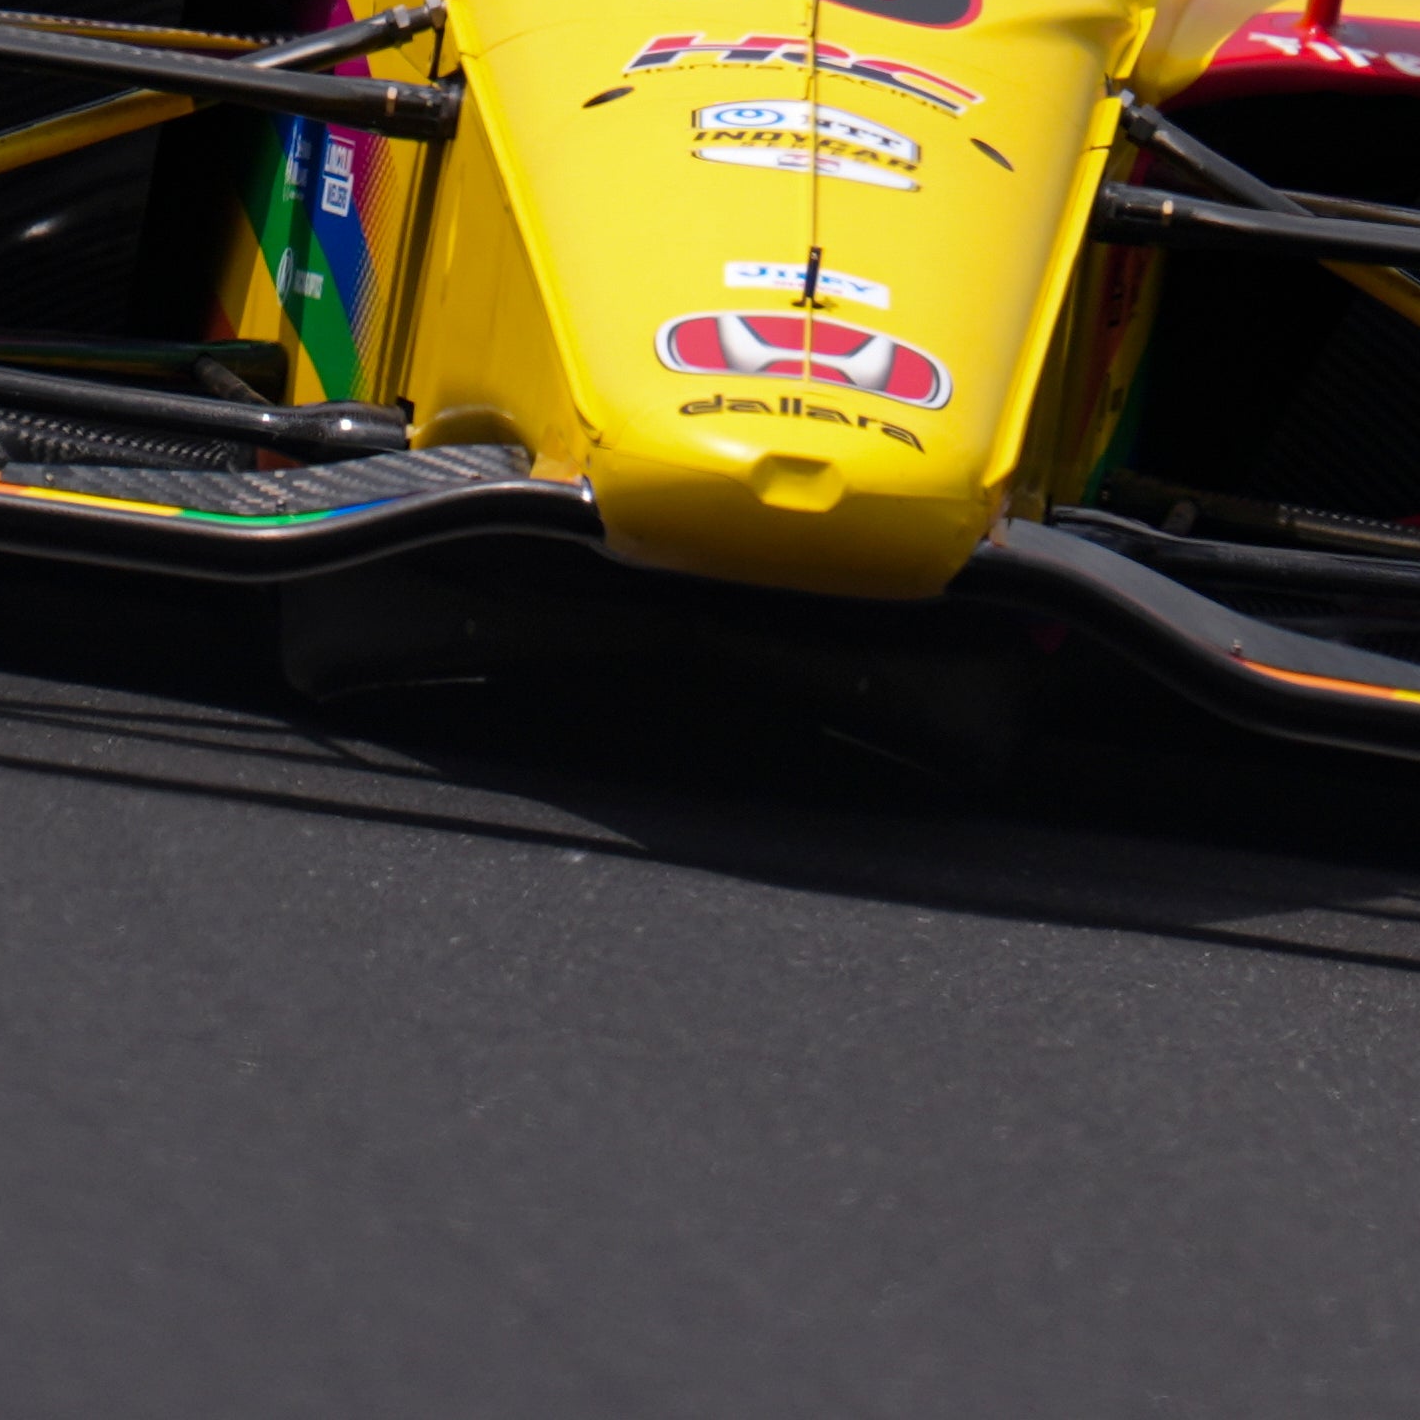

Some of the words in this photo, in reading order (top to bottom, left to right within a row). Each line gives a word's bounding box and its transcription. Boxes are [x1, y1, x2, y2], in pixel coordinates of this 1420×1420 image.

[623, 31, 985, 115] HRC
[692, 130, 918, 173] INDYCAR
[679, 394, 926, 454] dallara
